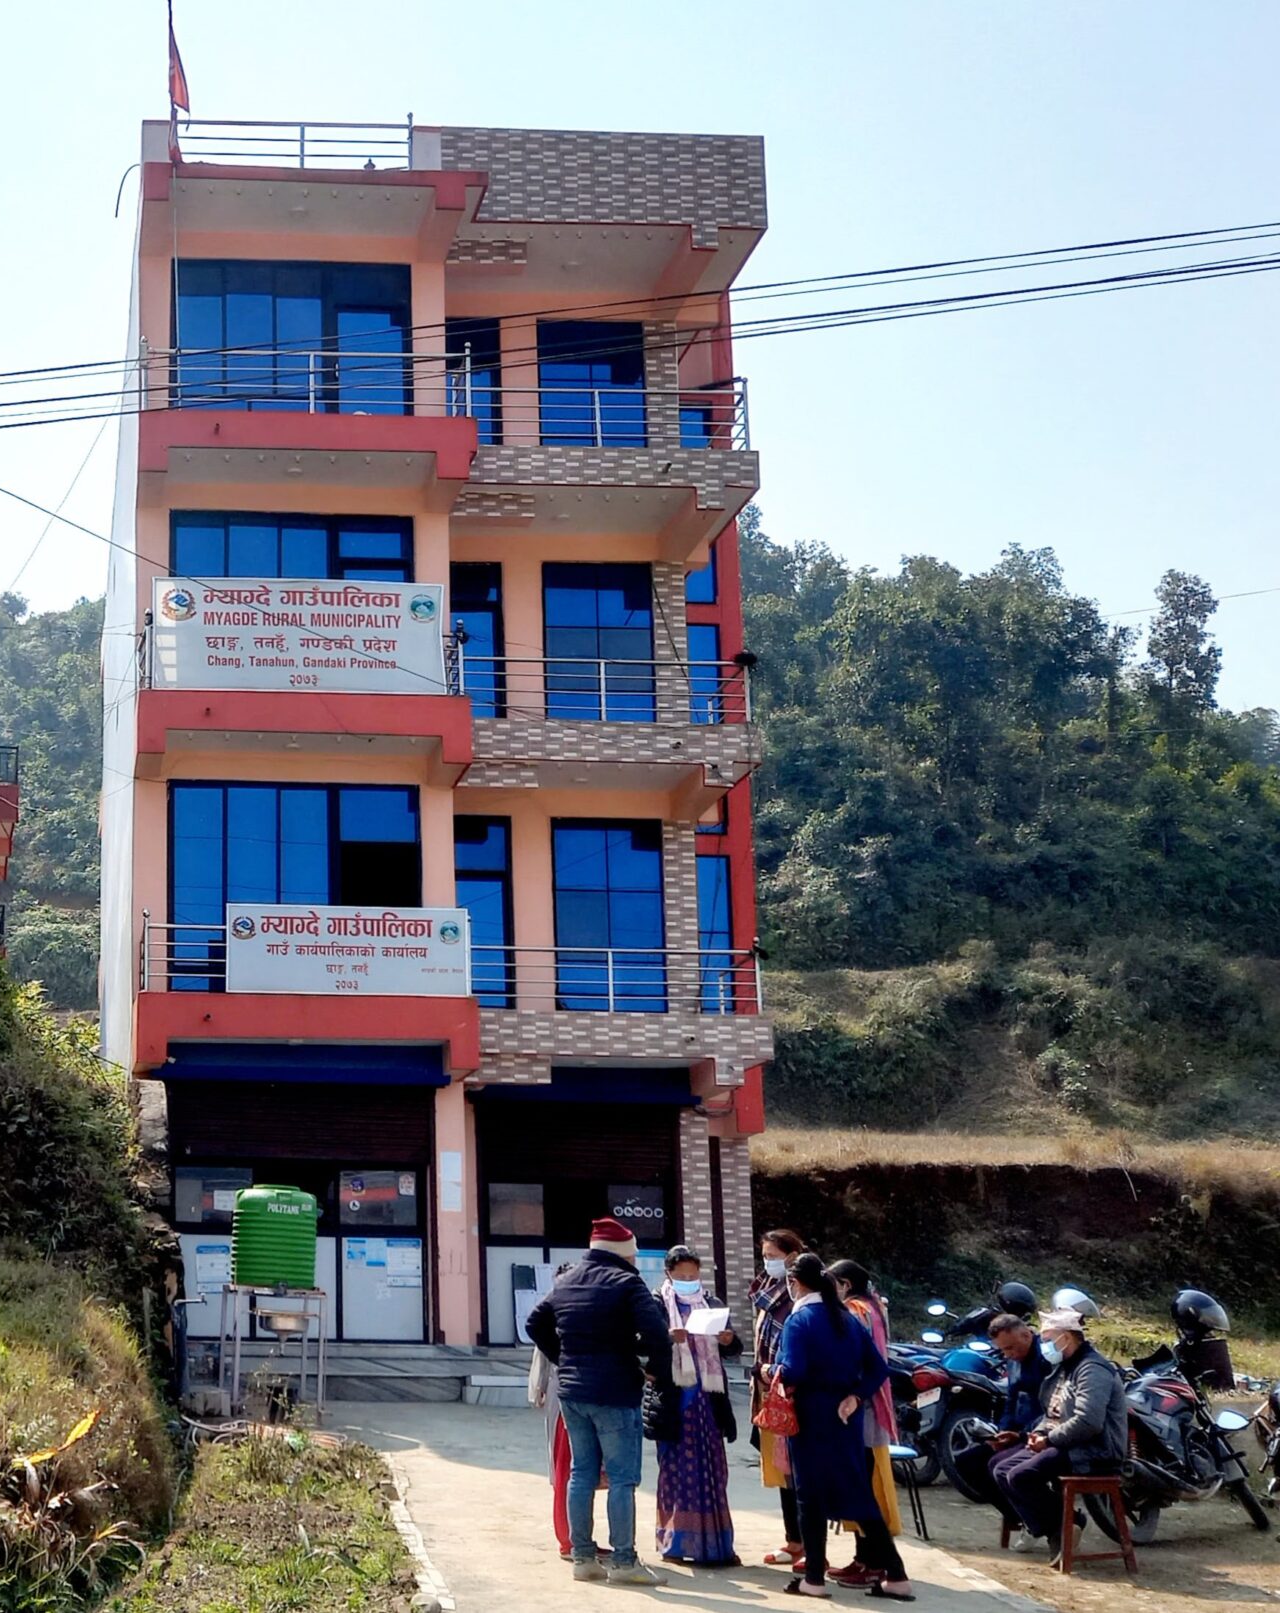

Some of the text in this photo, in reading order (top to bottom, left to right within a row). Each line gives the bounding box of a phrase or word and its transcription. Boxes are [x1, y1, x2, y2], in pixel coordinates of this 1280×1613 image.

[279, 585, 402, 608] गाउँपालिका
[203, 611, 402, 629] MYAGDE RURAL MUNICIPALITY
[299, 634, 355, 651] गण्डकी
[362, 636, 398, 653] प्रदेश
[207, 655, 397, 669] Chang, Tanahun, Gandaki Province
[289, 674, 319, 686] २०७३
[326, 912, 433, 938] गाउँपालिका
[266, 939, 428, 960] गाउँ कार्यपालिकाको कार्यालय
[267, 1202, 300, 1215] POLYTANK
